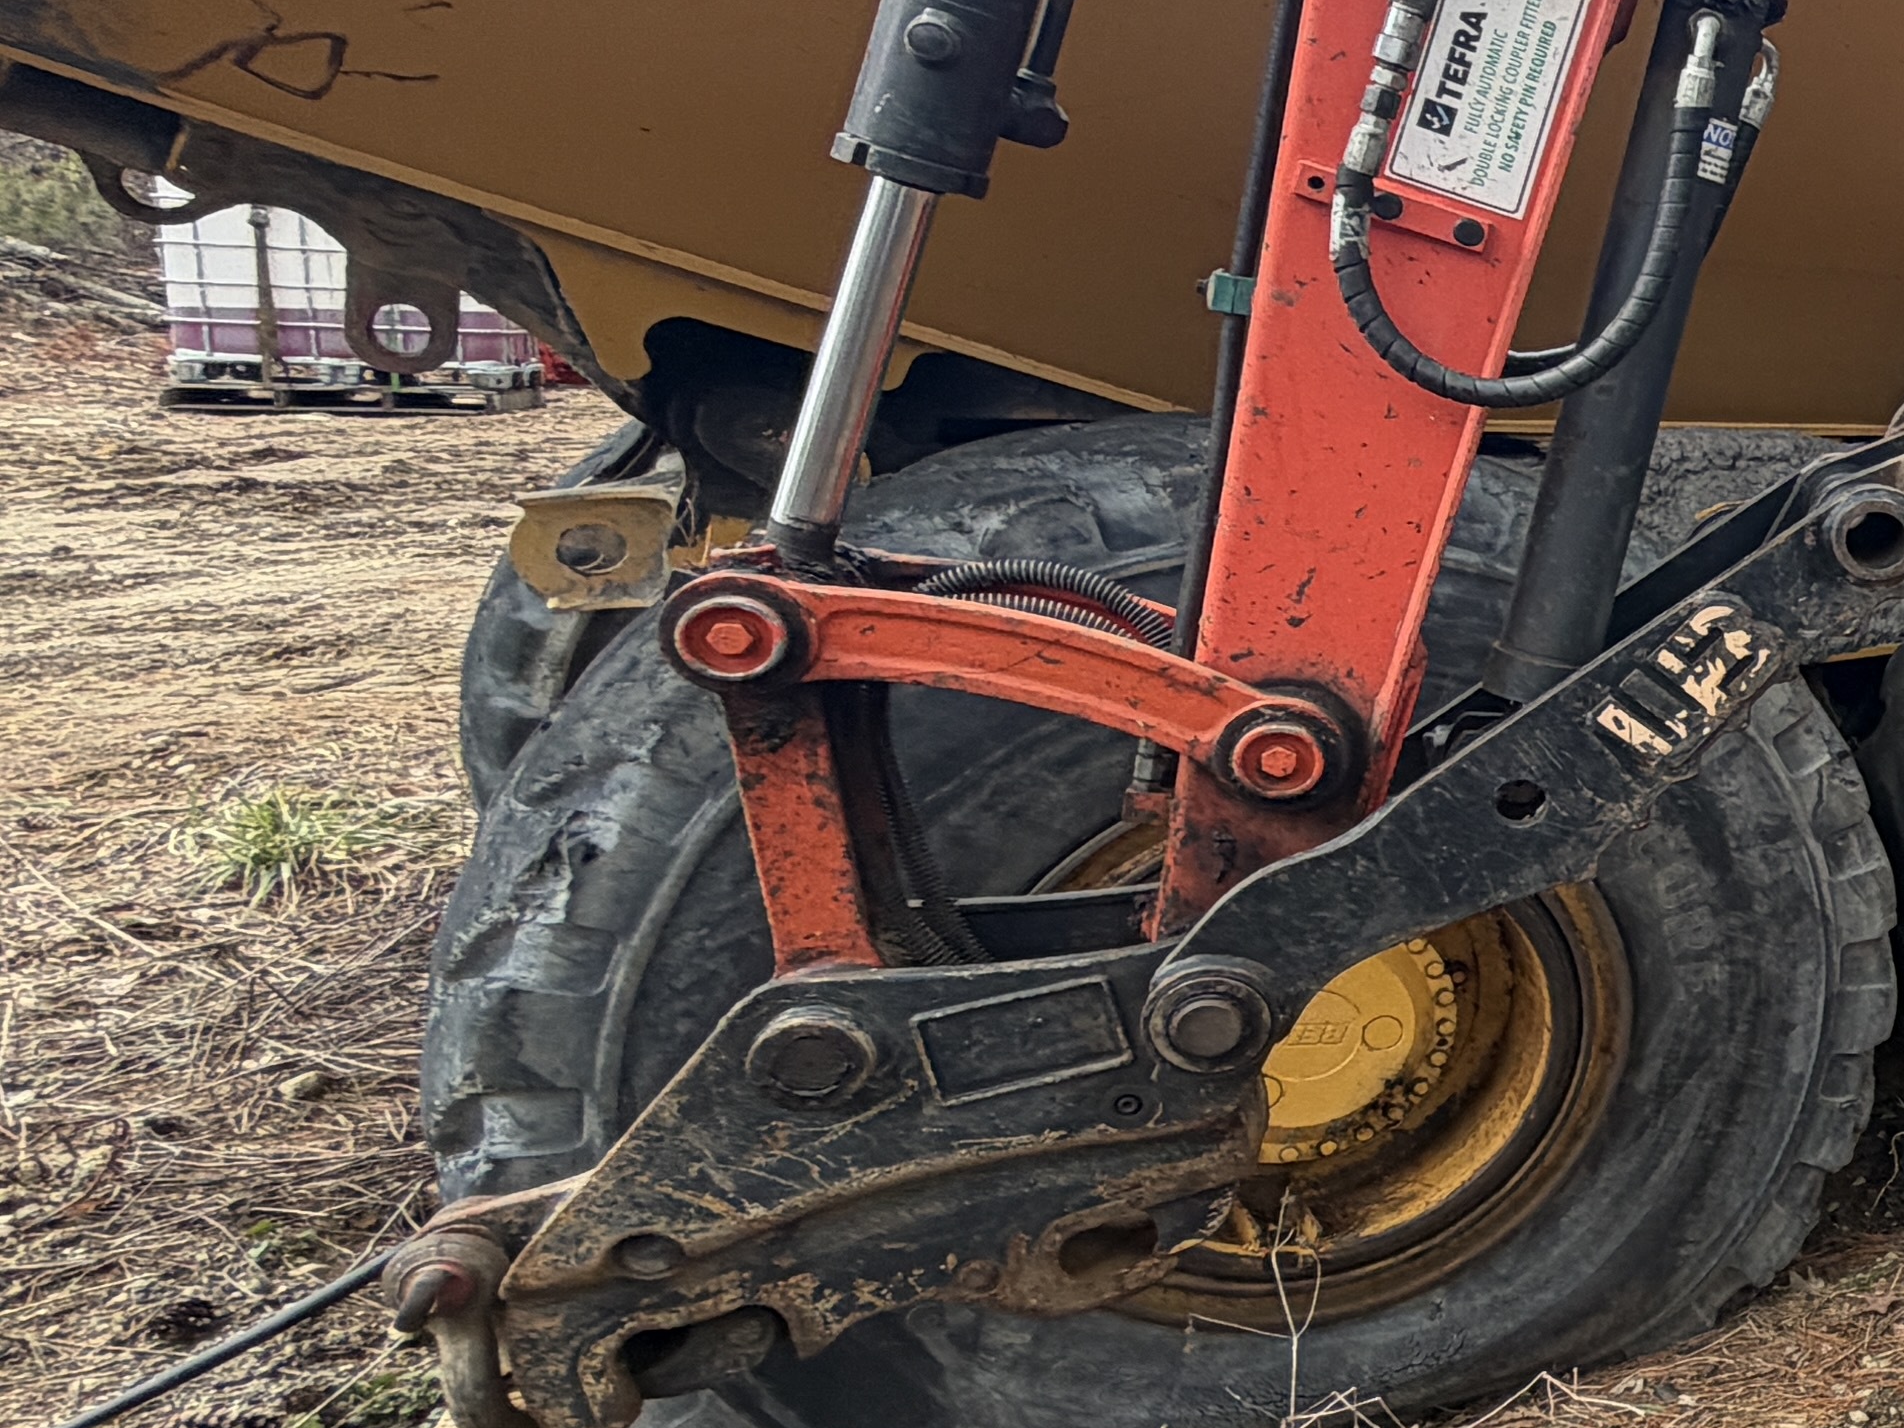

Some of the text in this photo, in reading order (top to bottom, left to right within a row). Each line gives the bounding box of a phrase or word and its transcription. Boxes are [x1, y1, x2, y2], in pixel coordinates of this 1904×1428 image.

[1435, 11, 1489, 101] TEFRA
[1464, 28, 1509, 134] FULLY AUTOMATIC
[1470, 140, 1497, 187] DOUBLE
[1485, 85, 1515, 139] LOCKING
[1505, 32, 1531, 84] COUPLER
[1497, 19, 1558, 173] NO SAFETY PIN REQUIRED
